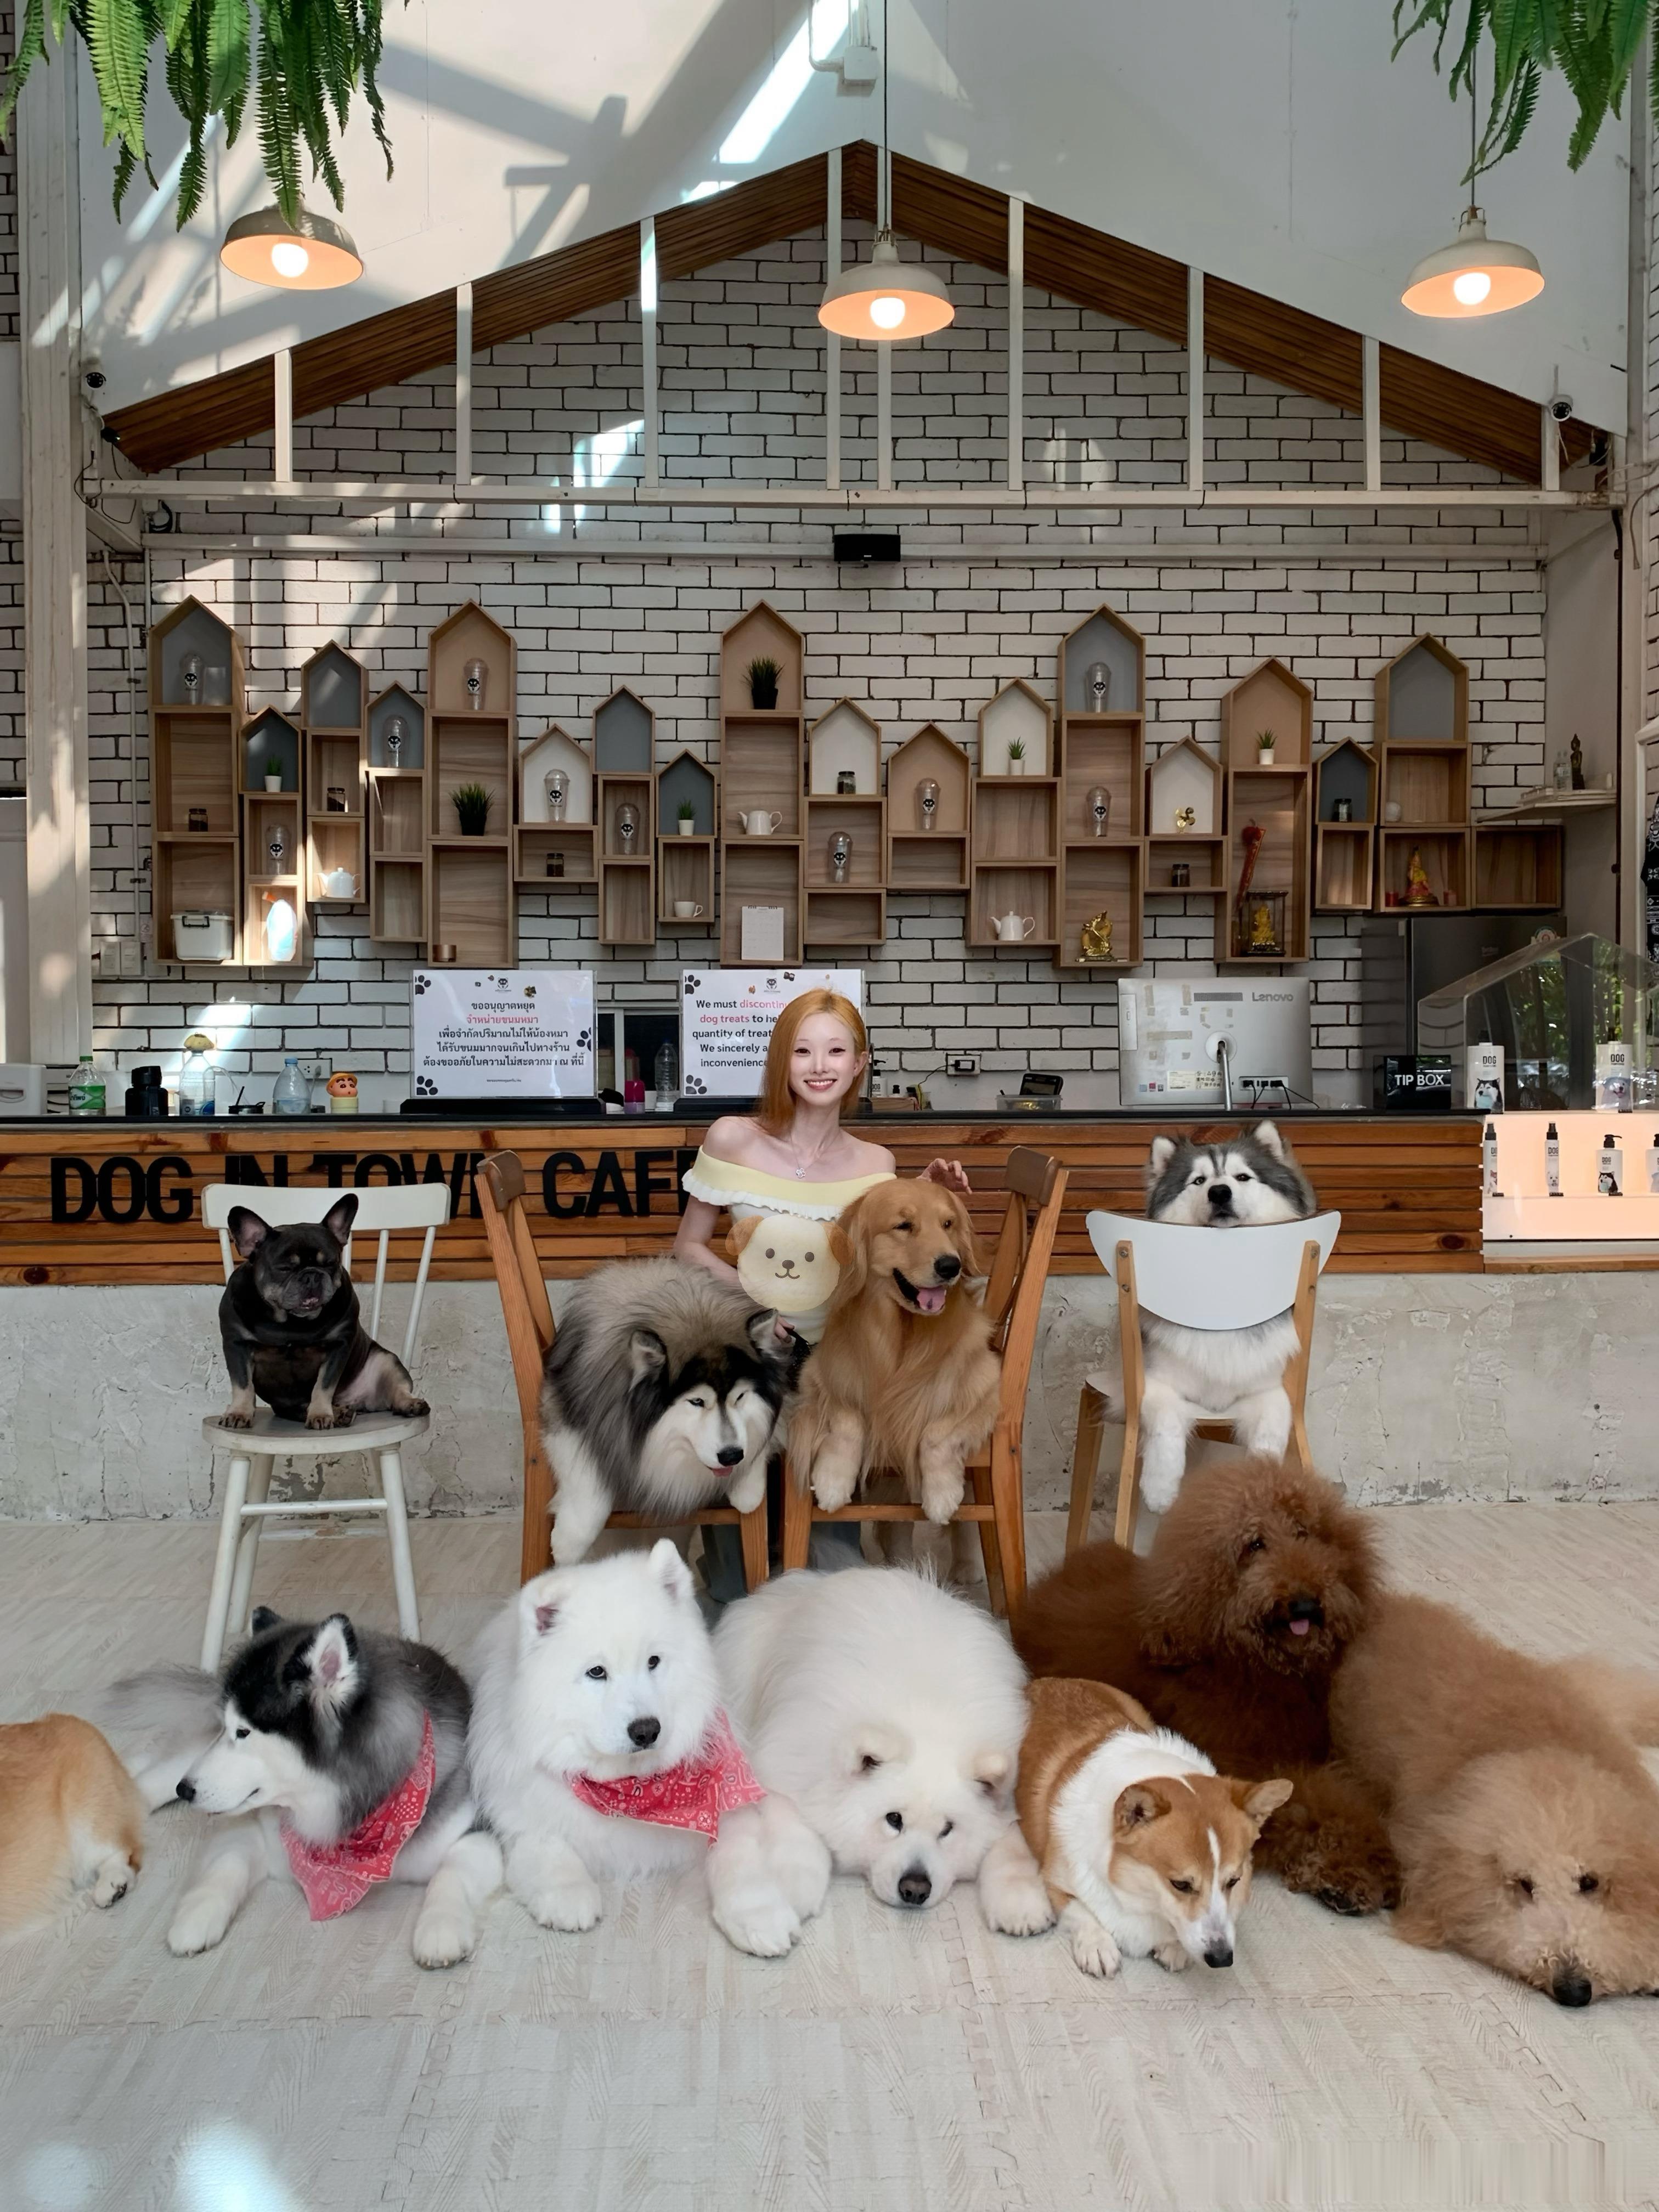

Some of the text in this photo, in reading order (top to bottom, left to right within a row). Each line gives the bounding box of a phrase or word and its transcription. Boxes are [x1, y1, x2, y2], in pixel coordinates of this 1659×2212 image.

[1252, 992, 1294, 1002] Lenovo
[471, 1002, 535, 1013] ขออนุญาตหยุด
[696, 1000, 711, 1008] We
[713, 1000, 737, 1008] must
[466, 1013, 539, 1024] จำหน่ายขนมหมา
[700, 1014, 718, 1025] dog
[720, 1015, 749, 1023] treats
[438, 1025, 568, 1039] เพื่อจำกัดปริมาณไม่ให้น้องหมา
[692, 1029, 733, 1040] quantity
[735, 1029, 746, 1037] of
[436, 1041, 570, 1052] ได้รับขนมมากจนเกินไปทางร้าน
[700, 1044, 715, 1052] We
[717, 1043, 760, 1054] sincerely
[1483, 1056, 1497, 1064] DOG
[1611, 1054, 1624, 1063] DOG
[1394, 1074, 1444, 1086] TIP BOX
[50, 1156, 194, 1223] DOG
